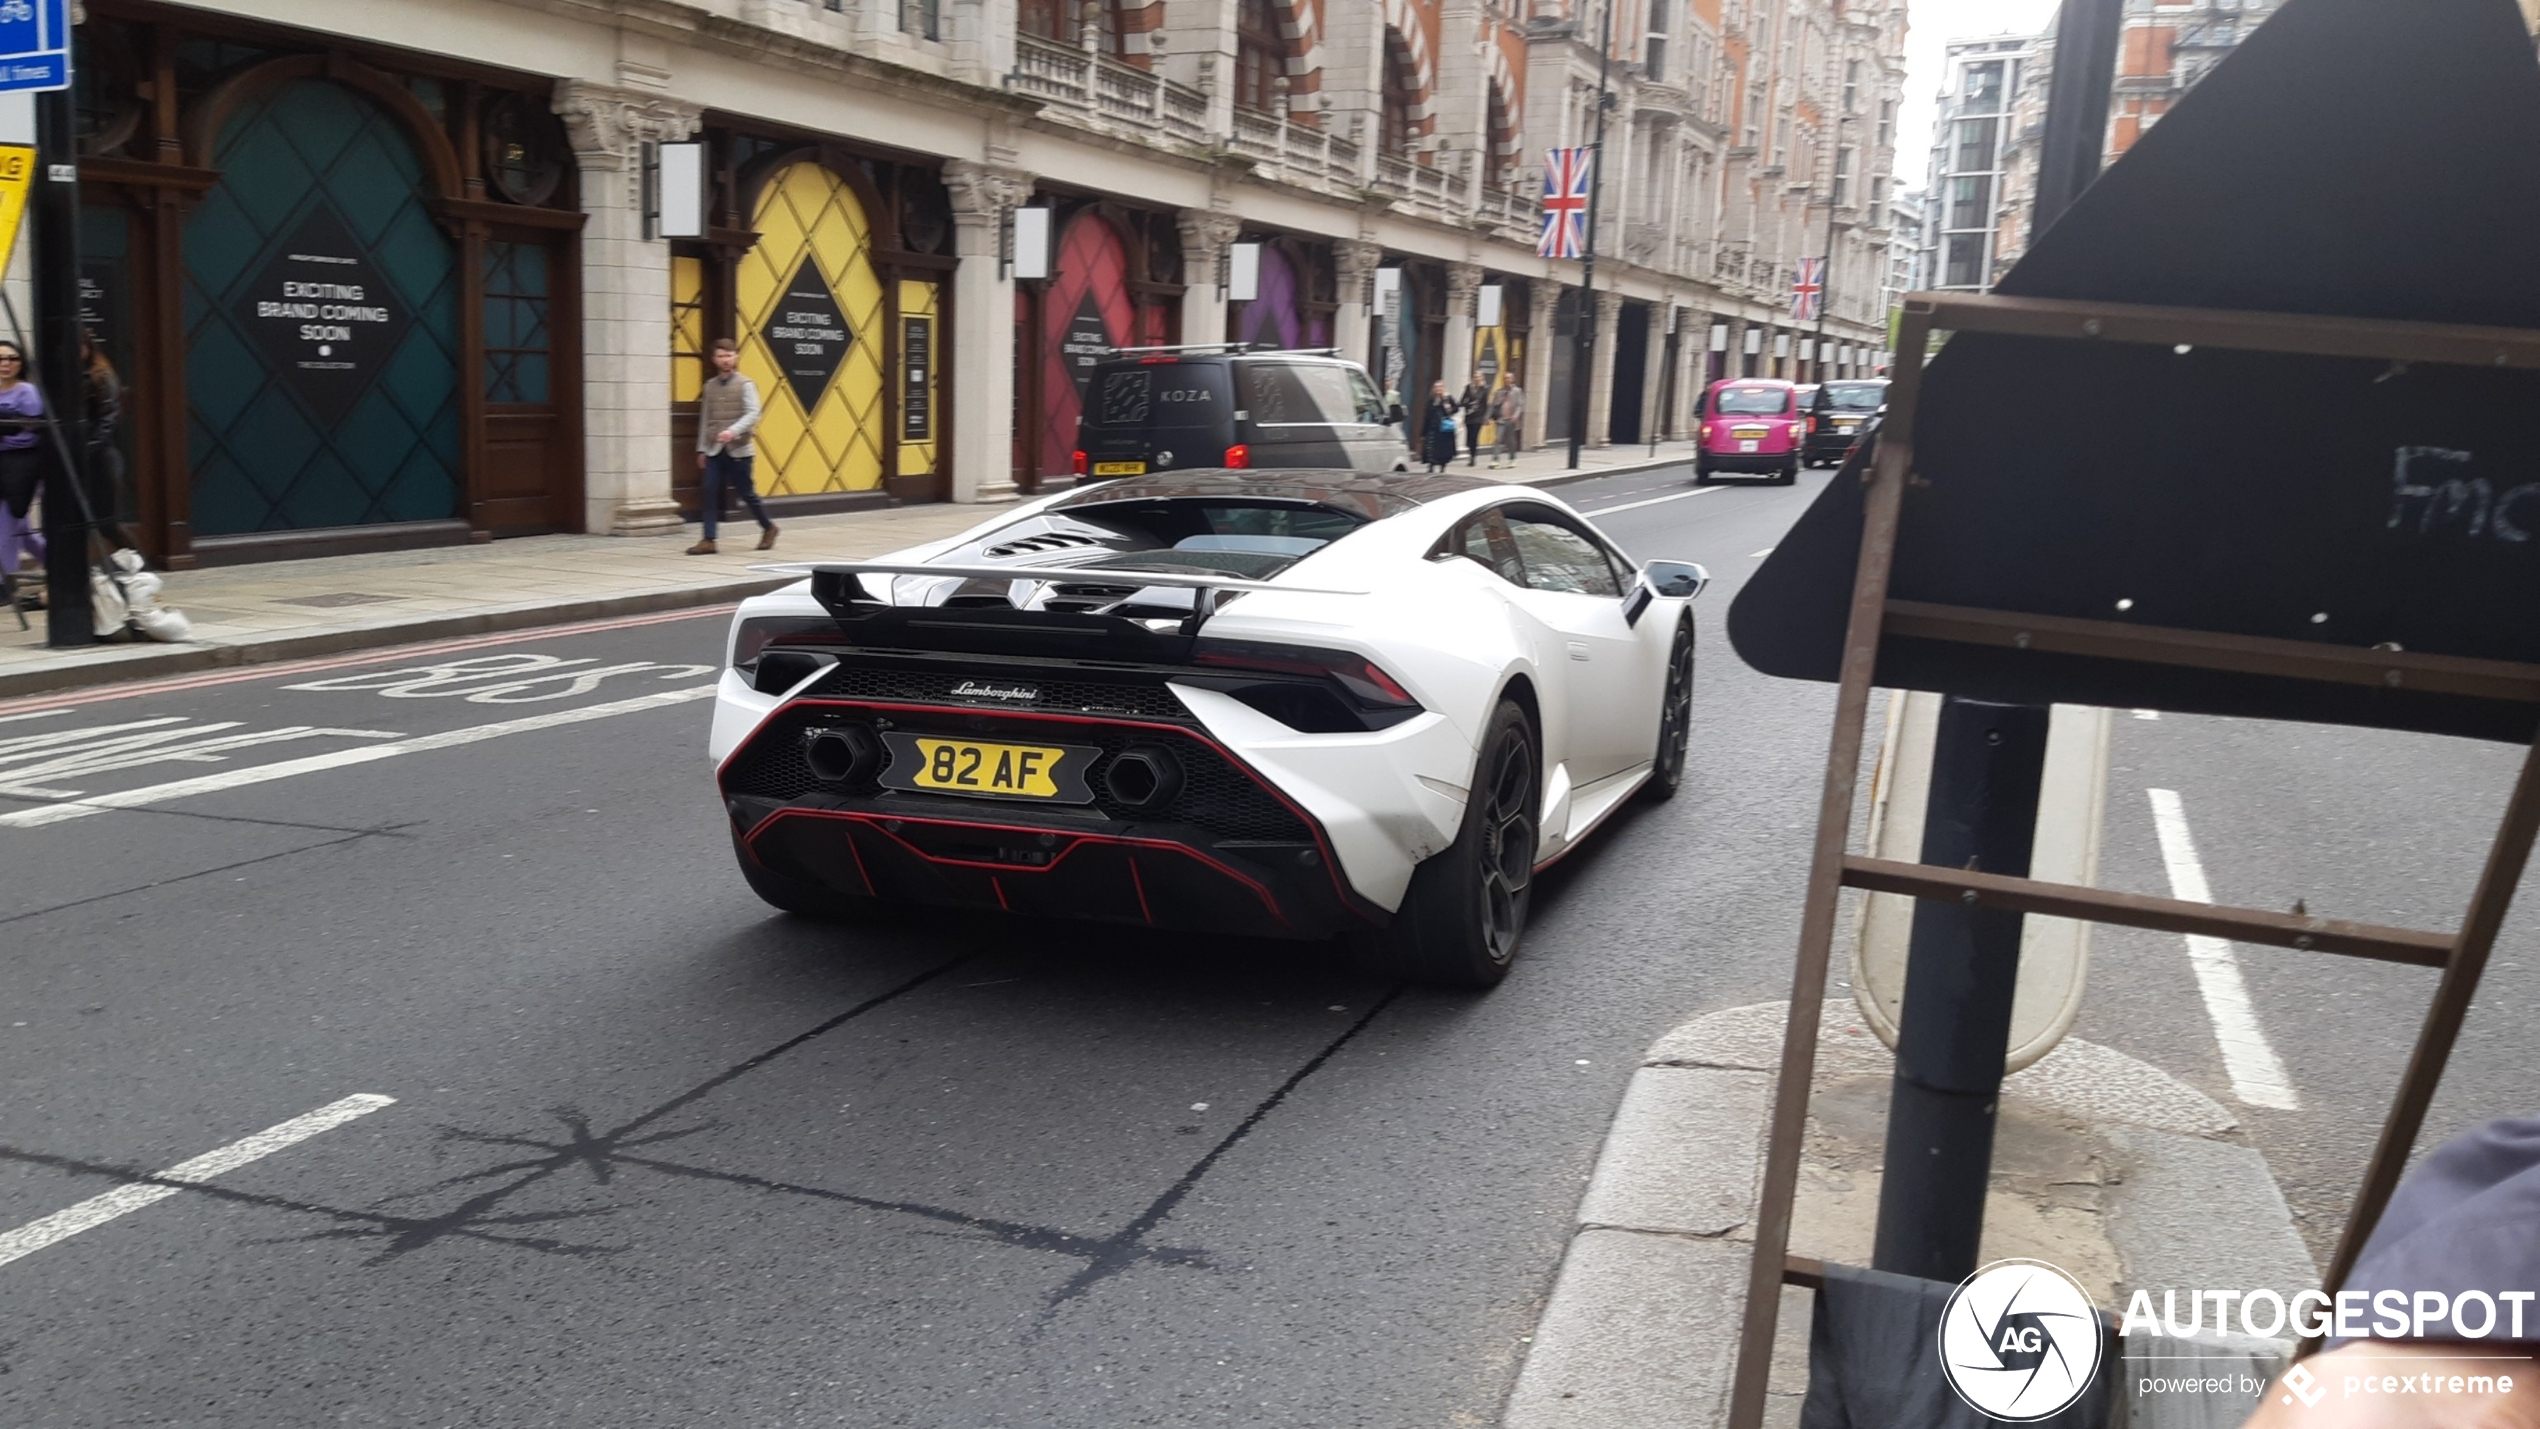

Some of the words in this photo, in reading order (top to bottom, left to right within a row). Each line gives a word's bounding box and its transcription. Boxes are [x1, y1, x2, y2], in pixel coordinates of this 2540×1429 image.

[283, 281, 364, 300] EXCITING
[257, 301, 319, 319] BRAND
[320, 304, 389, 322] COMING
[786, 312, 831, 325] EXCITING
[300, 324, 350, 341] SOON
[794, 343, 823, 355] SOON
[1160, 390, 1212, 402] KOZA
[278, 653, 716, 703] BUS
[951, 681, 1038, 700] Lamborghini
[932, 745, 981, 786] 82
[992, 749, 1043, 789] AF
